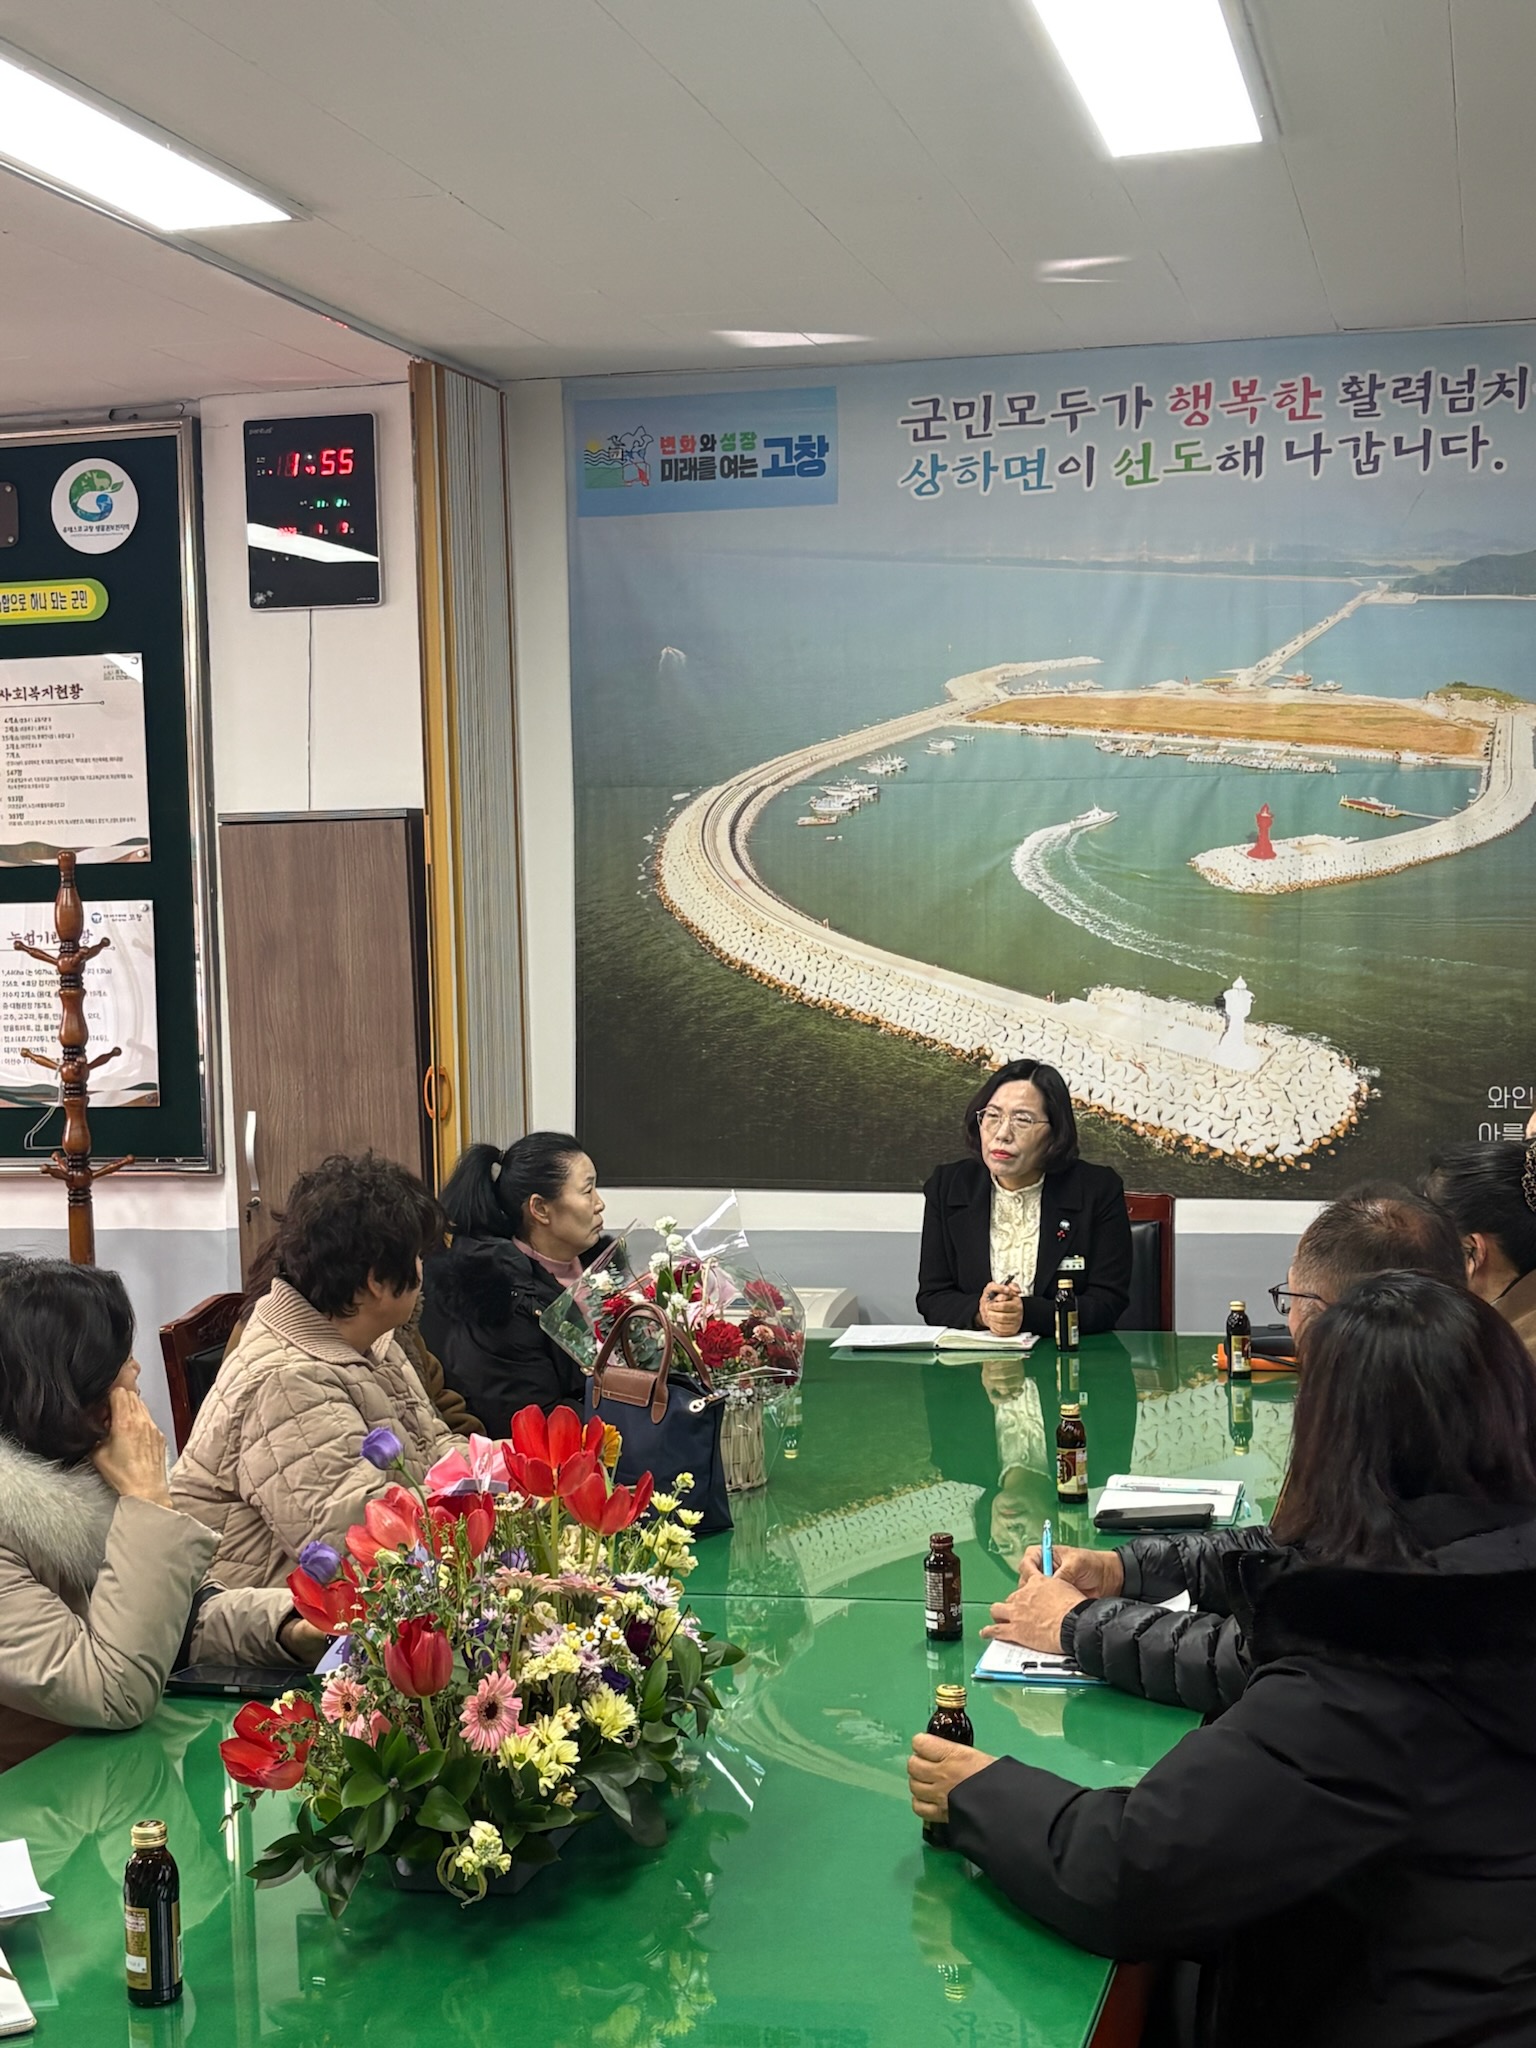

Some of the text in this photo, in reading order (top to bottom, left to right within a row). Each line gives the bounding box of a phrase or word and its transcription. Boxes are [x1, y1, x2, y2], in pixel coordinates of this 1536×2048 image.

[900, 386, 1153, 442] 군민모두가
[1168, 377, 1324, 427] 행복한
[660, 431, 757, 455] 변화와 성장
[761, 434, 829, 478] 고창
[660, 453, 758, 482] 미래를 여는
[900, 445, 1095, 498] 상하면이
[1113, 433, 1266, 487] 선도해
[31, 592, 47, 611] 하나
[51, 591, 68, 610] 되는
[71, 590, 88, 609] 군민
[1487, 1086, 1533, 1109] 와인
